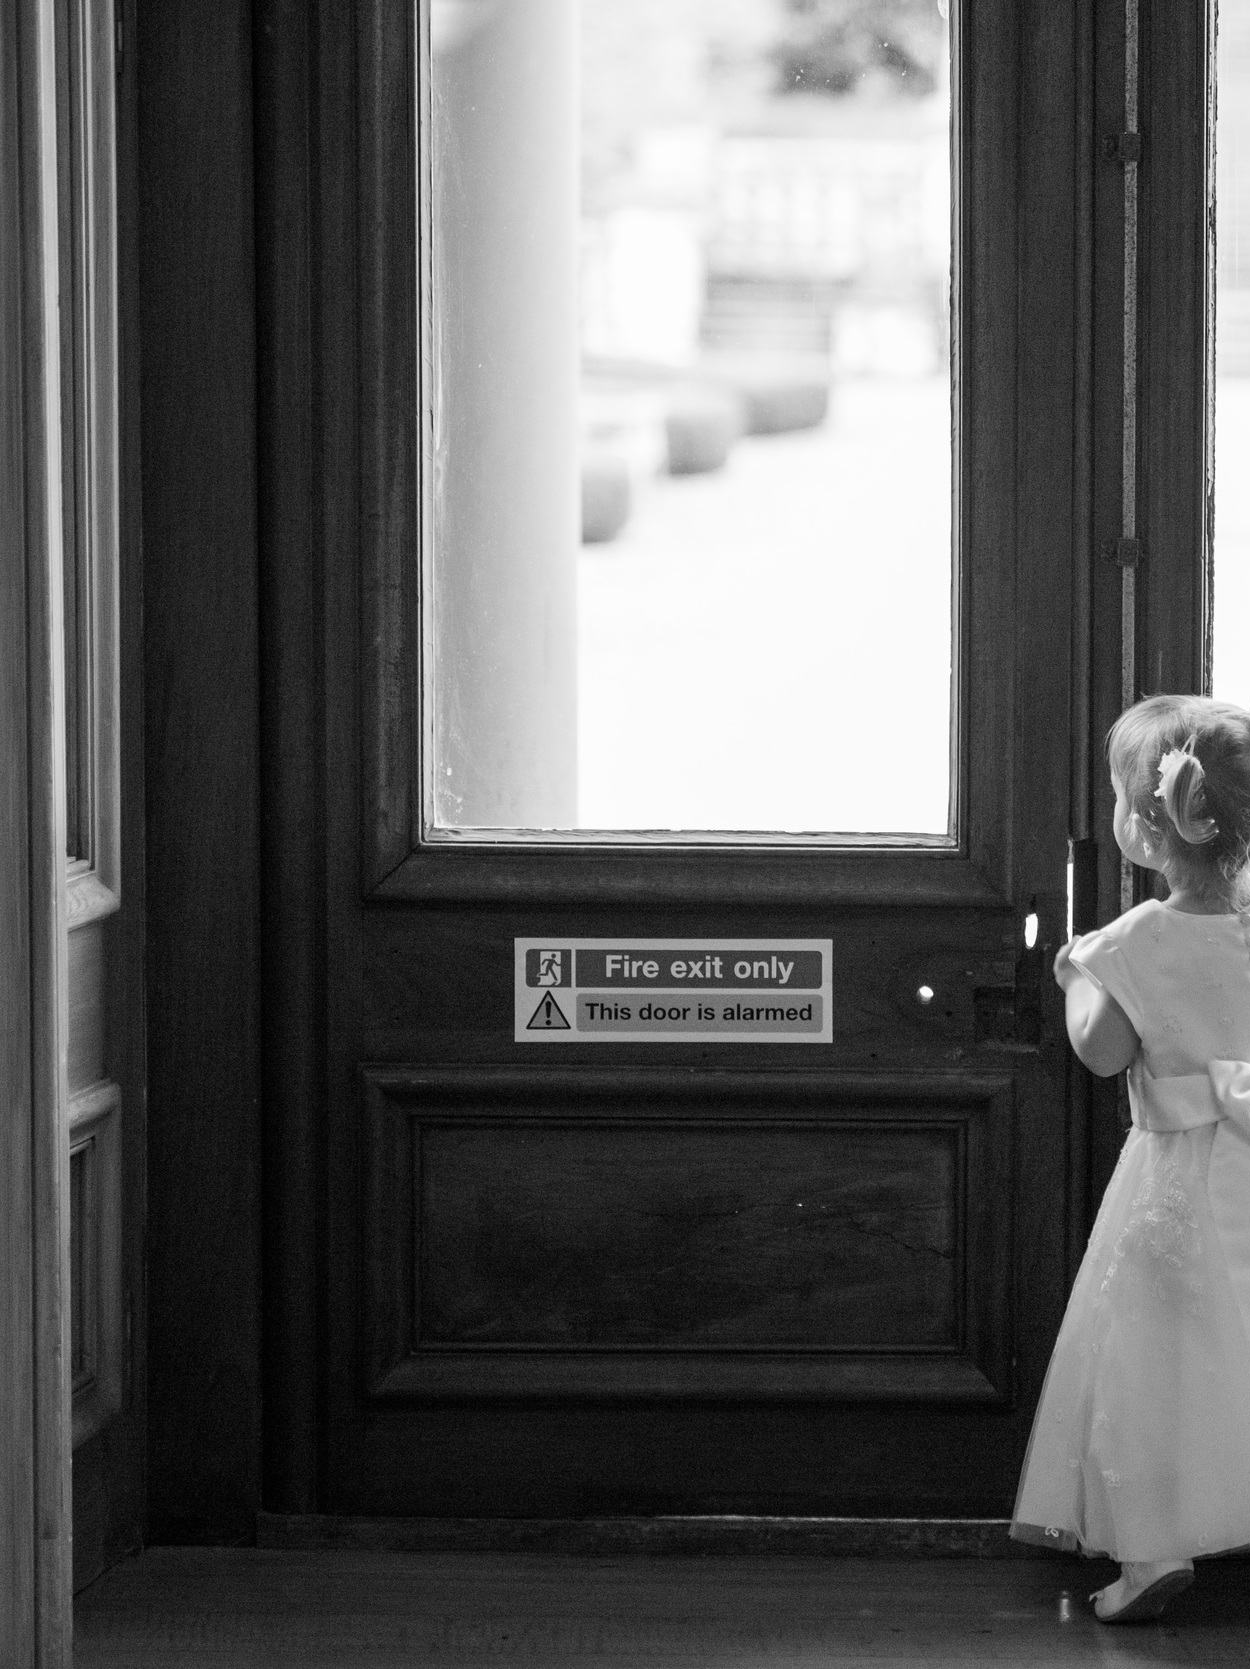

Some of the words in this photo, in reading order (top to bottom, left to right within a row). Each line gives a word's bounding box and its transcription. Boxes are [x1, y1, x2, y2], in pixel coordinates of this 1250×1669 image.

[605, 954, 659, 979] Fire
[670, 955, 723, 979] exit
[733, 956, 795, 984] only
[585, 1002, 632, 1021] This
[638, 1003, 690, 1021] door
[697, 1003, 716, 1021] is
[722, 1003, 813, 1021] alarmed
